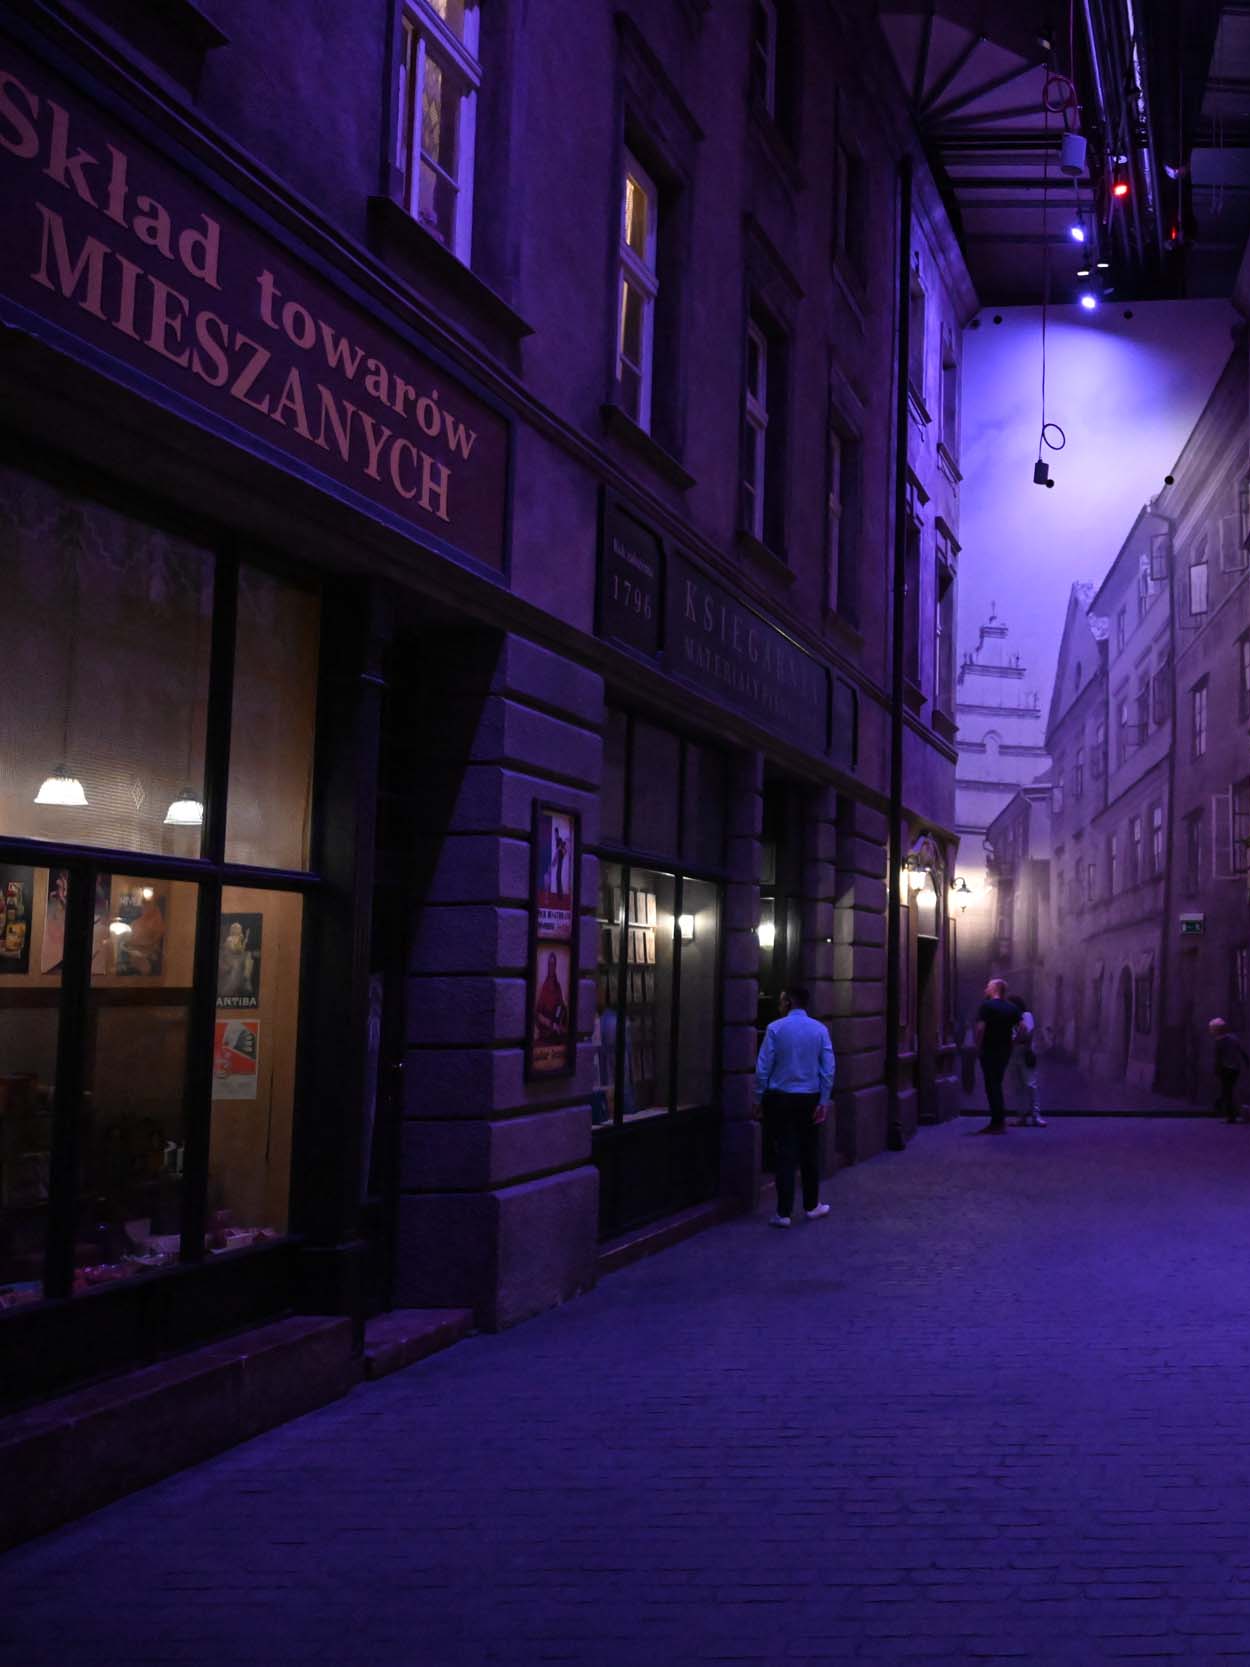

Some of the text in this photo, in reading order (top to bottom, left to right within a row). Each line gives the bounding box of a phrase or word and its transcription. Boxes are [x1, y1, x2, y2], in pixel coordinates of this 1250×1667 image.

[0, 71, 478, 461] Skład towarów
[30, 201, 452, 523] MIESZANYCH
